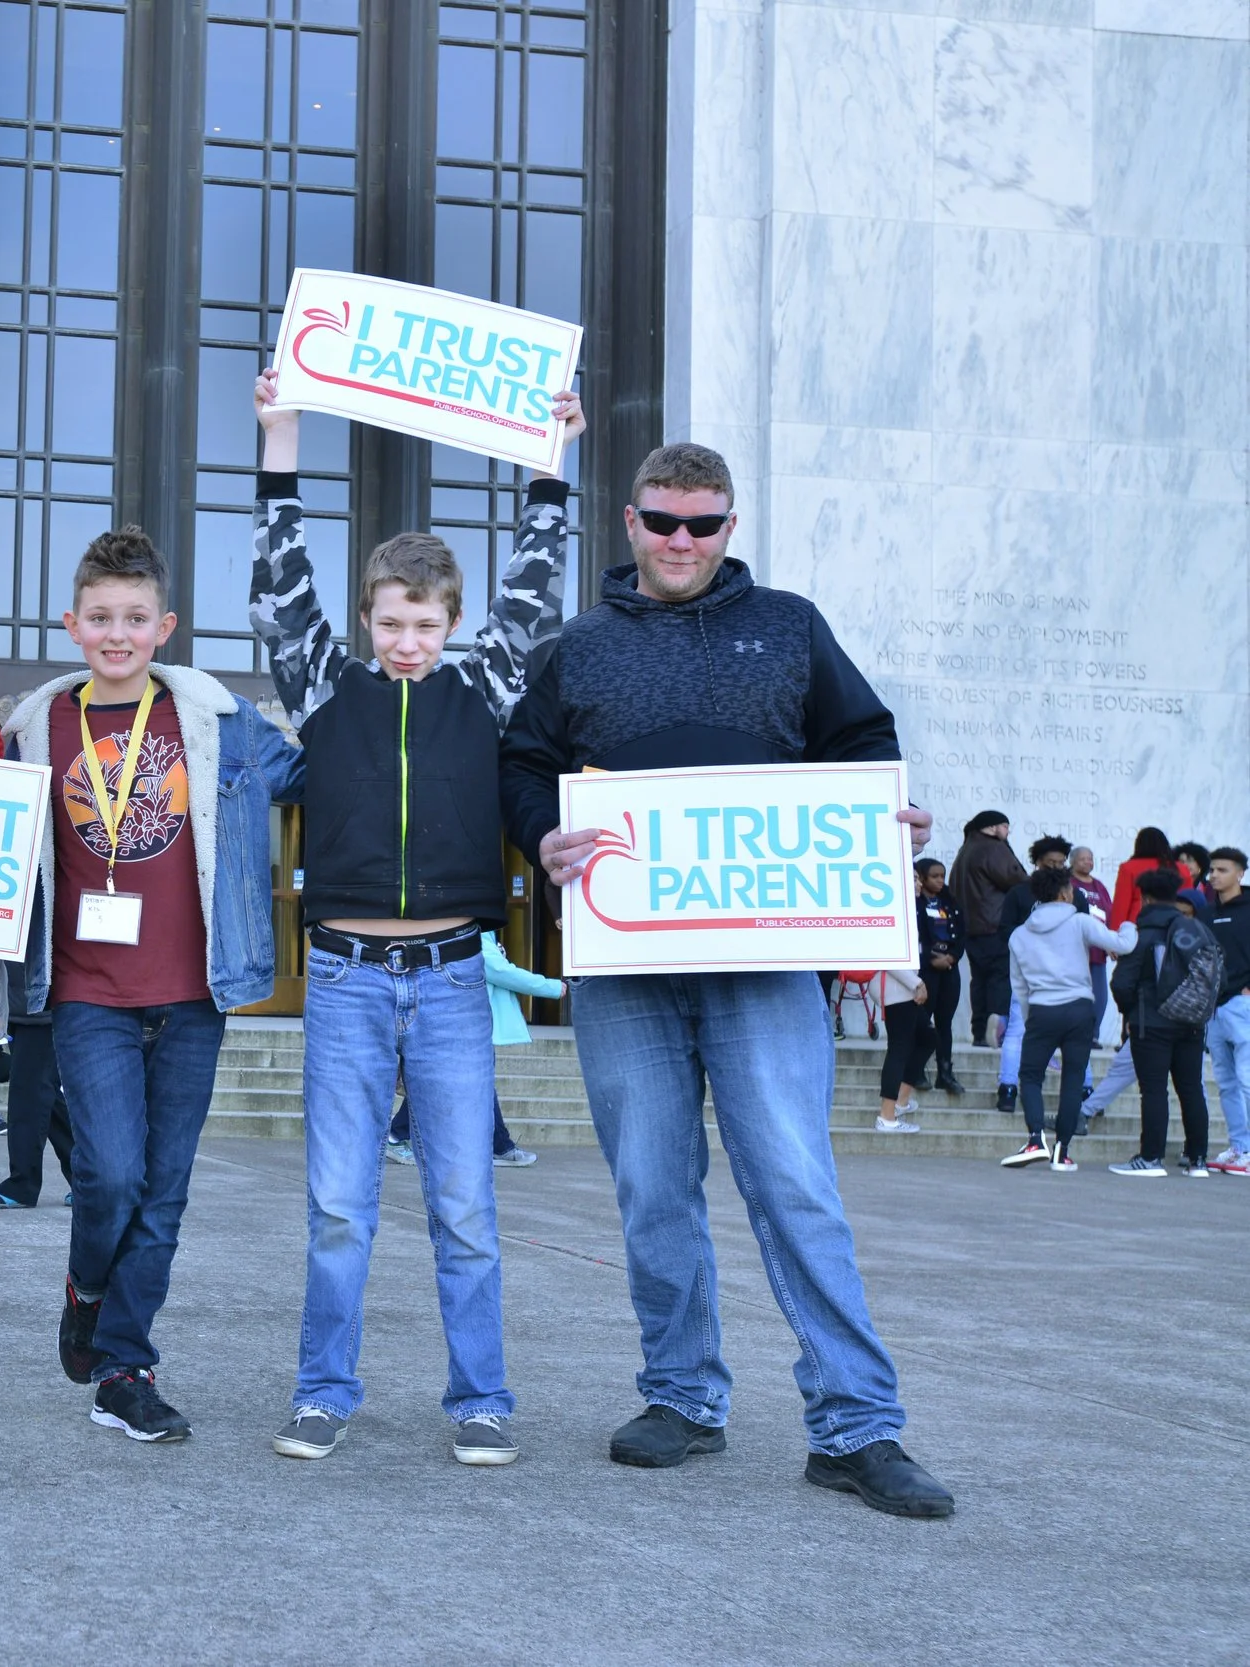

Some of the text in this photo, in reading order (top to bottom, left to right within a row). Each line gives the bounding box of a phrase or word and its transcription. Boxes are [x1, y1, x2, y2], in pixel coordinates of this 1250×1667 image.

[358, 305, 561, 386] I TRUST
[350, 344, 552, 422] PARENTS
[934, 589, 1090, 613] THE MIND OF MAN
[900, 619, 1129, 648] KNOWS NO EMPLOYMENT
[876, 650, 1147, 681] MORE WORTHY OF ITS POWERS
[896, 684, 930, 700] THE
[940, 686, 1001, 704] QUEST
[1006, 690, 1034, 706] OF
[1041, 692, 1184, 715] RIGHTEOUSNESS
[927, 718, 1103, 744] IN HUMAN AFFAIRS
[933, 752, 981, 769] GOAL
[987, 754, 1015, 770] OF
[1020, 756, 1044, 773] ITS
[1051, 757, 1135, 777] LABOURS
[920, 782, 1101, 808] THAT IS SUPERIOR TO
[650, 804, 888, 861] I TRUST
[1055, 822, 1089, 839] THE
[1097, 824, 1138, 840] GOO
[650, 862, 893, 910] PARENTS
